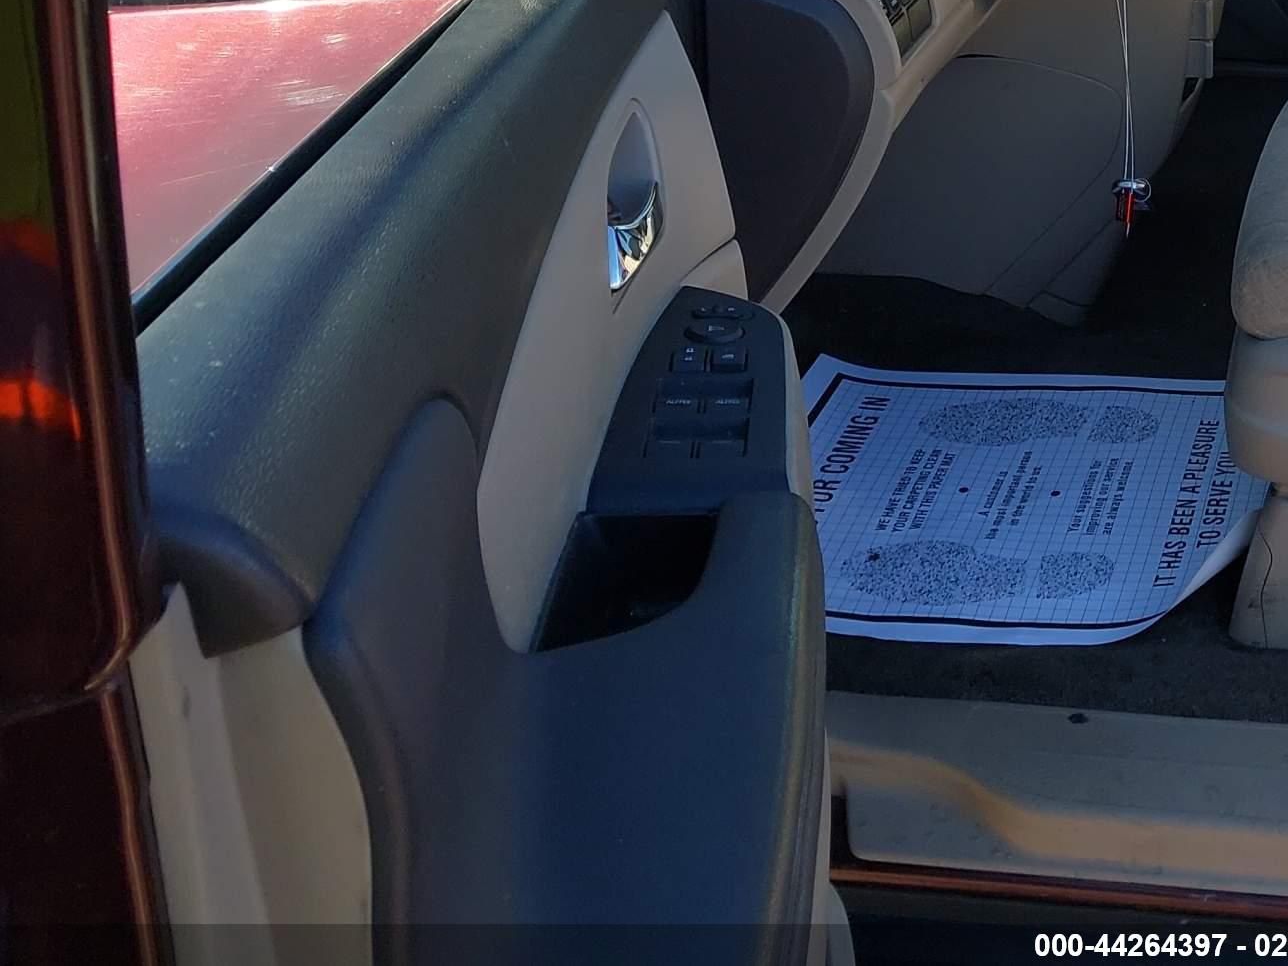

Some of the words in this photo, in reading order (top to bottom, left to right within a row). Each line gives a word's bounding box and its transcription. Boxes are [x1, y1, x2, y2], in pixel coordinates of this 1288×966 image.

[819, 415, 880, 474] COMING
[858, 396, 891, 411] IN
[910, 448, 926, 465] KEEP
[940, 451, 957, 467] MAT
[1183, 419, 1220, 481] PLEASURE
[904, 466, 918, 475] TO
[928, 467, 950, 490] PAPER
[1103, 457, 1120, 482] service
[892, 475, 912, 496] TRIED
[1098, 483, 1110, 495] our
[1179, 484, 1201, 494] A
[880, 497, 901, 518] HAVE
[891, 512, 911, 533] YOUR
[902, 471, 931, 510] CARPETING
[919, 490, 938, 508] THIS
[983, 528, 999, 540] the
[993, 508, 1008, 526] most
[1001, 474, 1023, 507] important
[1066, 515, 1083, 533] Your
[1075, 470, 1099, 513] suggestions
[1106, 494, 1124, 520] always
[1203, 480, 1233, 525] SERVE
[909, 509, 929, 530] WITH
[1011, 505, 1025, 517] the
[1085, 497, 1109, 536] improving
[1168, 498, 1198, 536] BEEN
[875, 518, 891, 530] WE
[1102, 521, 1115, 535] are
[1196, 530, 1222, 548] TO
[1158, 540, 1187, 570] HAS
[1153, 574, 1177, 588] IT
